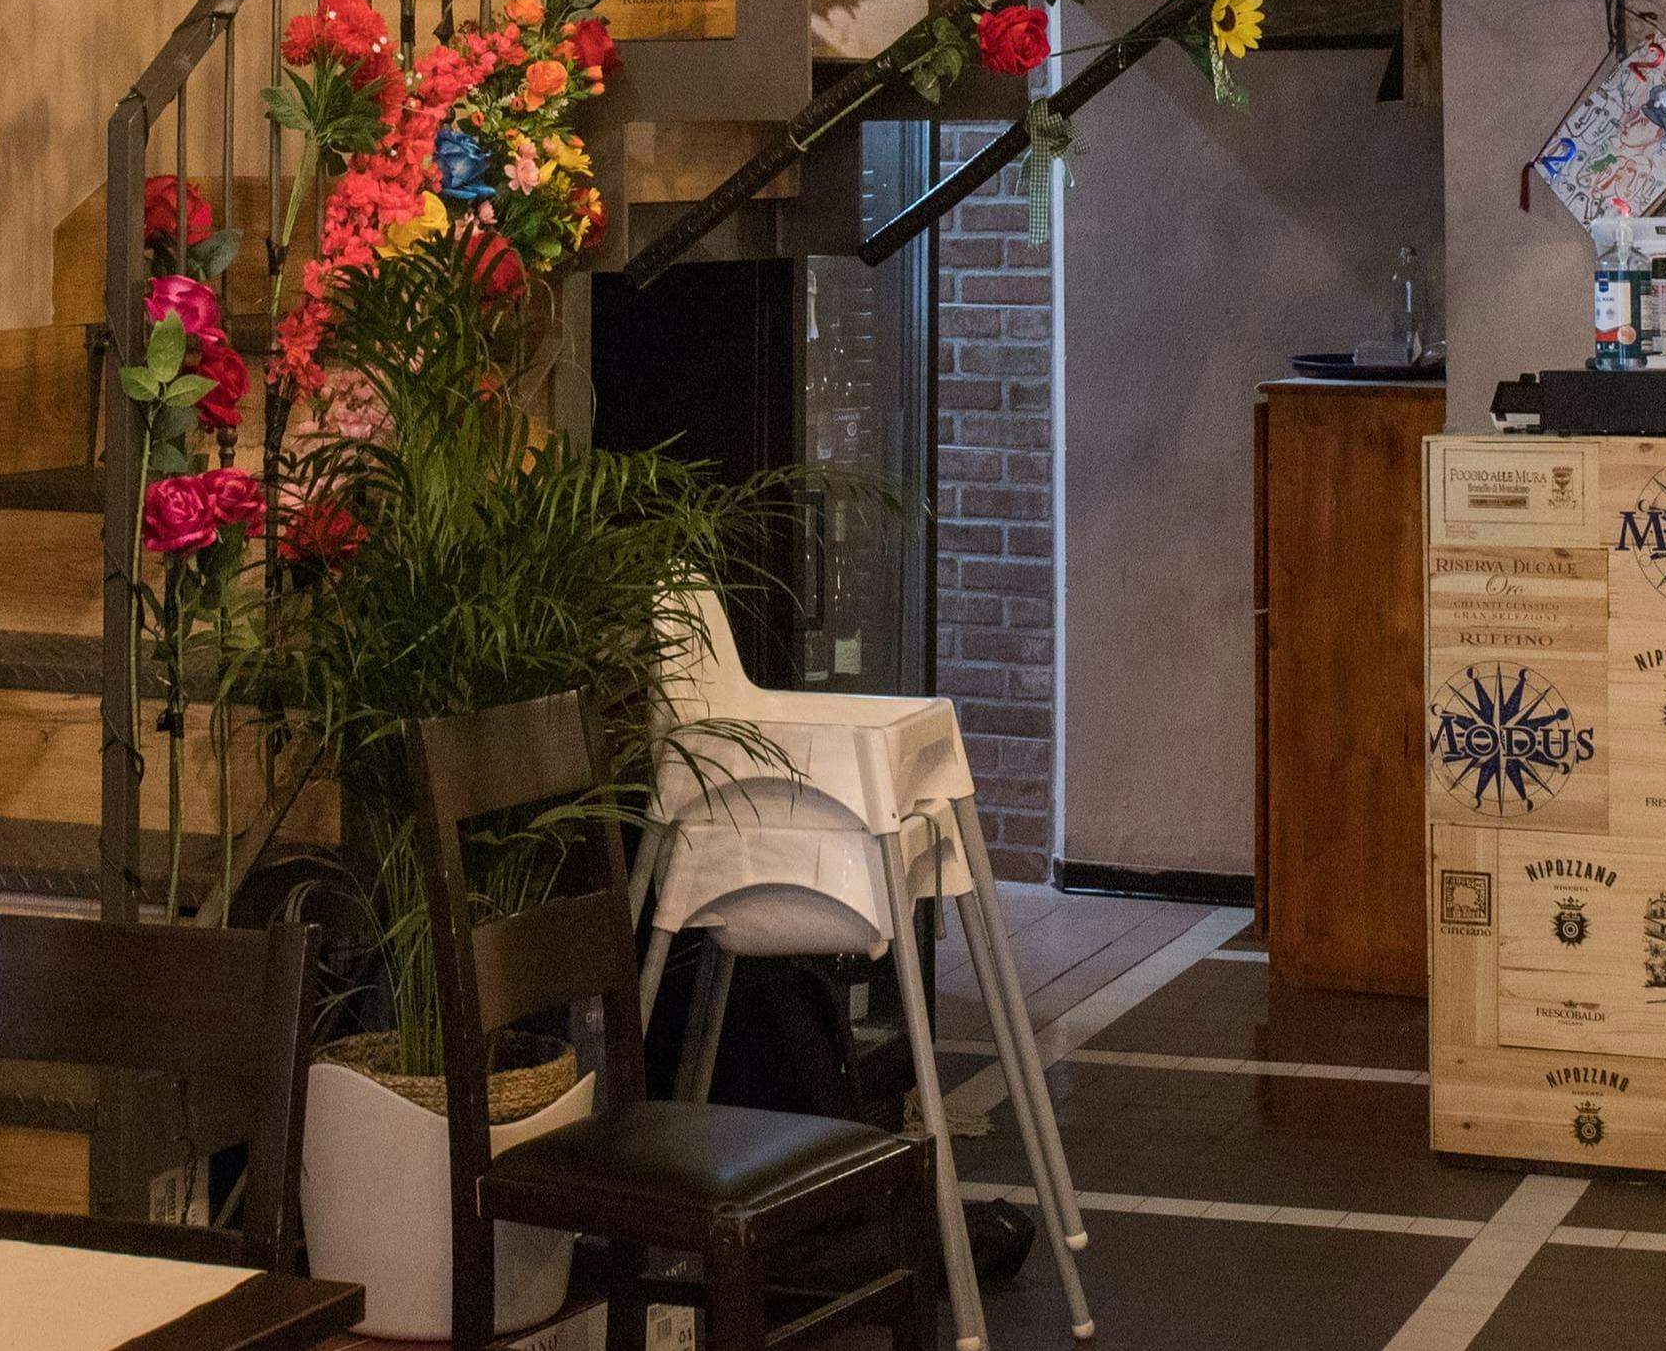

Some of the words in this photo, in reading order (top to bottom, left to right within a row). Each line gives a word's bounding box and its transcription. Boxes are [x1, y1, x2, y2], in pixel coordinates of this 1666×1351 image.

[1450, 468, 1489, 482] POGGIO
[1491, 472, 1513, 482] ALLE
[1515, 469, 1548, 484] MURA
[1436, 557, 1505, 573] RISERVA
[1513, 559, 1577, 576] DUCALE
[1485, 573, 1524, 596] Oro
[1452, 600, 1502, 610] CHIANTI
[1504, 601, 1561, 611] CLASSICO
[1453, 611, 1488, 620] GRAN
[1492, 611, 1559, 623] SELEZIONE
[1459, 631, 1555, 647] RUFFINO
[1525, 858, 1618, 888] NIPOZZANO
[1440, 926, 1492, 937] cinciano
[1536, 1007, 1605, 1022] FRESCOBALDI
[1545, 1066, 1630, 1093] NIPOZZANO
